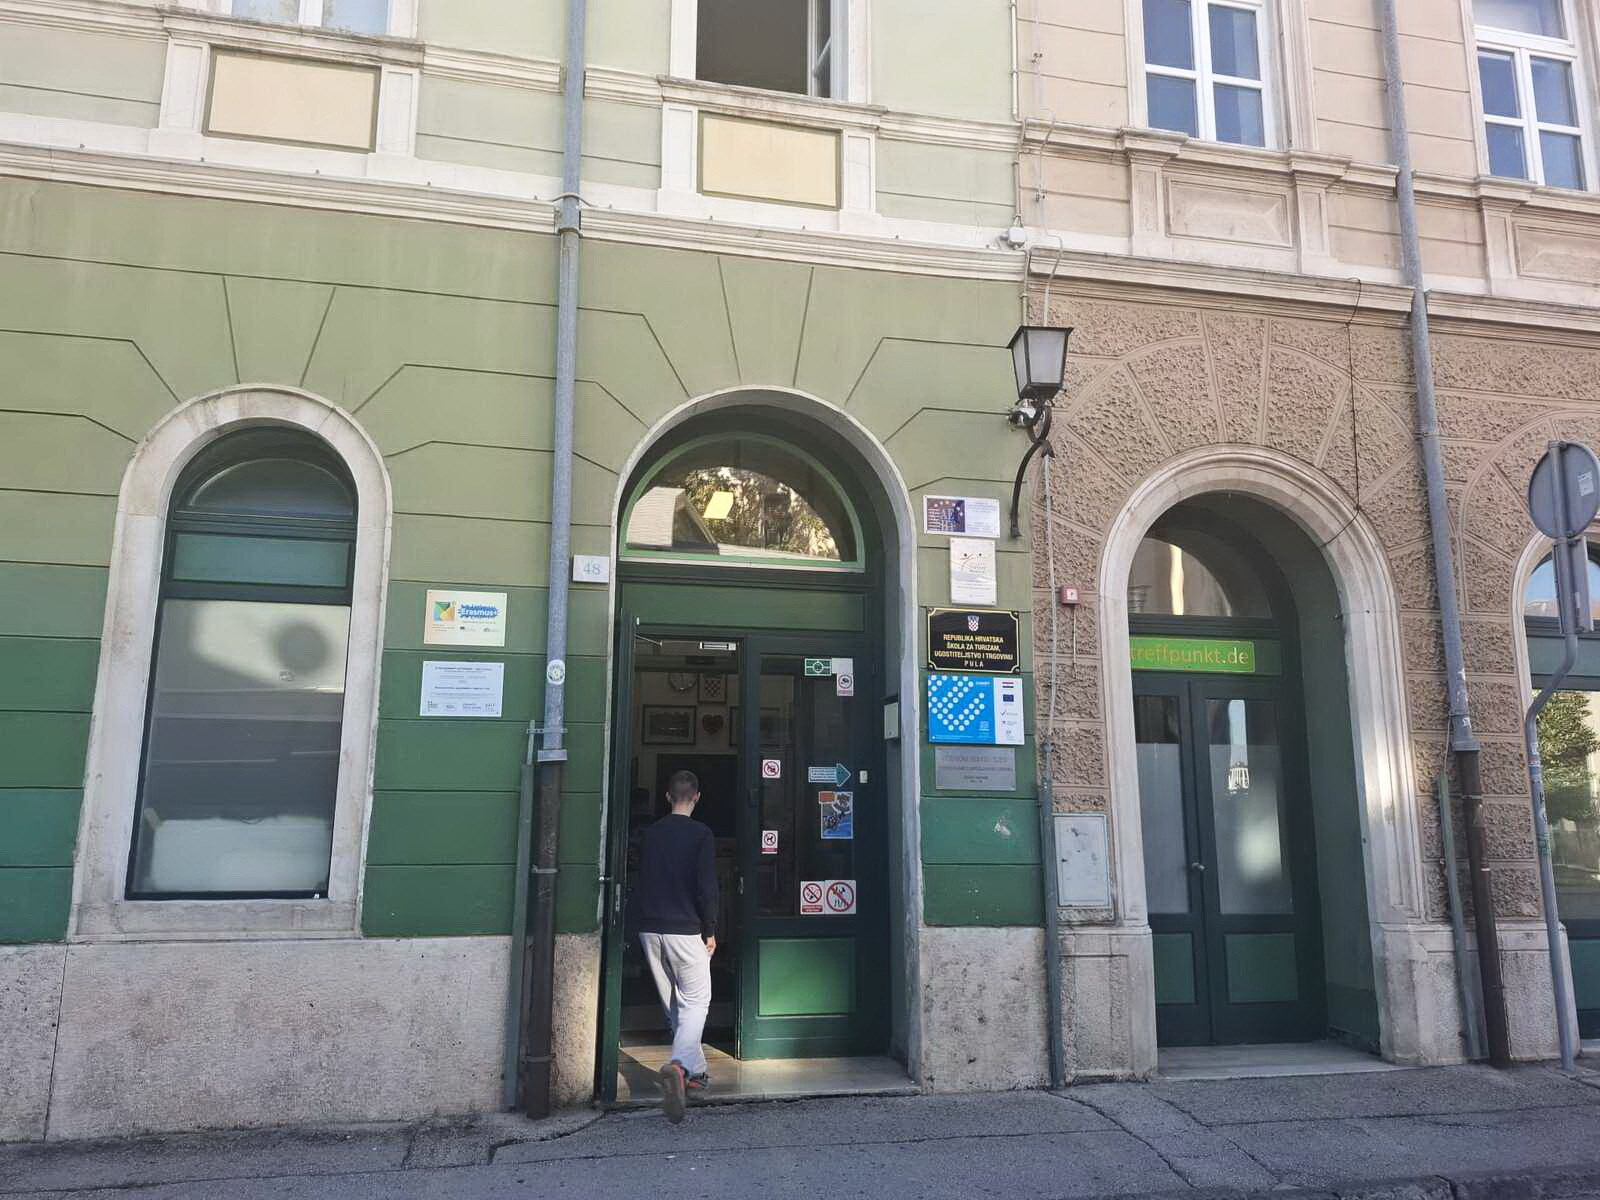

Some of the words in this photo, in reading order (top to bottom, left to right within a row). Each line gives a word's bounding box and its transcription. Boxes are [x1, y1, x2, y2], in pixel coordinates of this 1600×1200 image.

[583, 562, 601, 576] 48
[461, 608, 497, 617] Erasmus+
[943, 633, 974, 642] REPUBLIKA
[975, 635, 1004, 643] HRVATSKA
[946, 641, 965, 650] ŠKOLA
[934, 650, 982, 659] UGOSTITELJSTVO
[986, 653, 1013, 661] TRGOVINU
